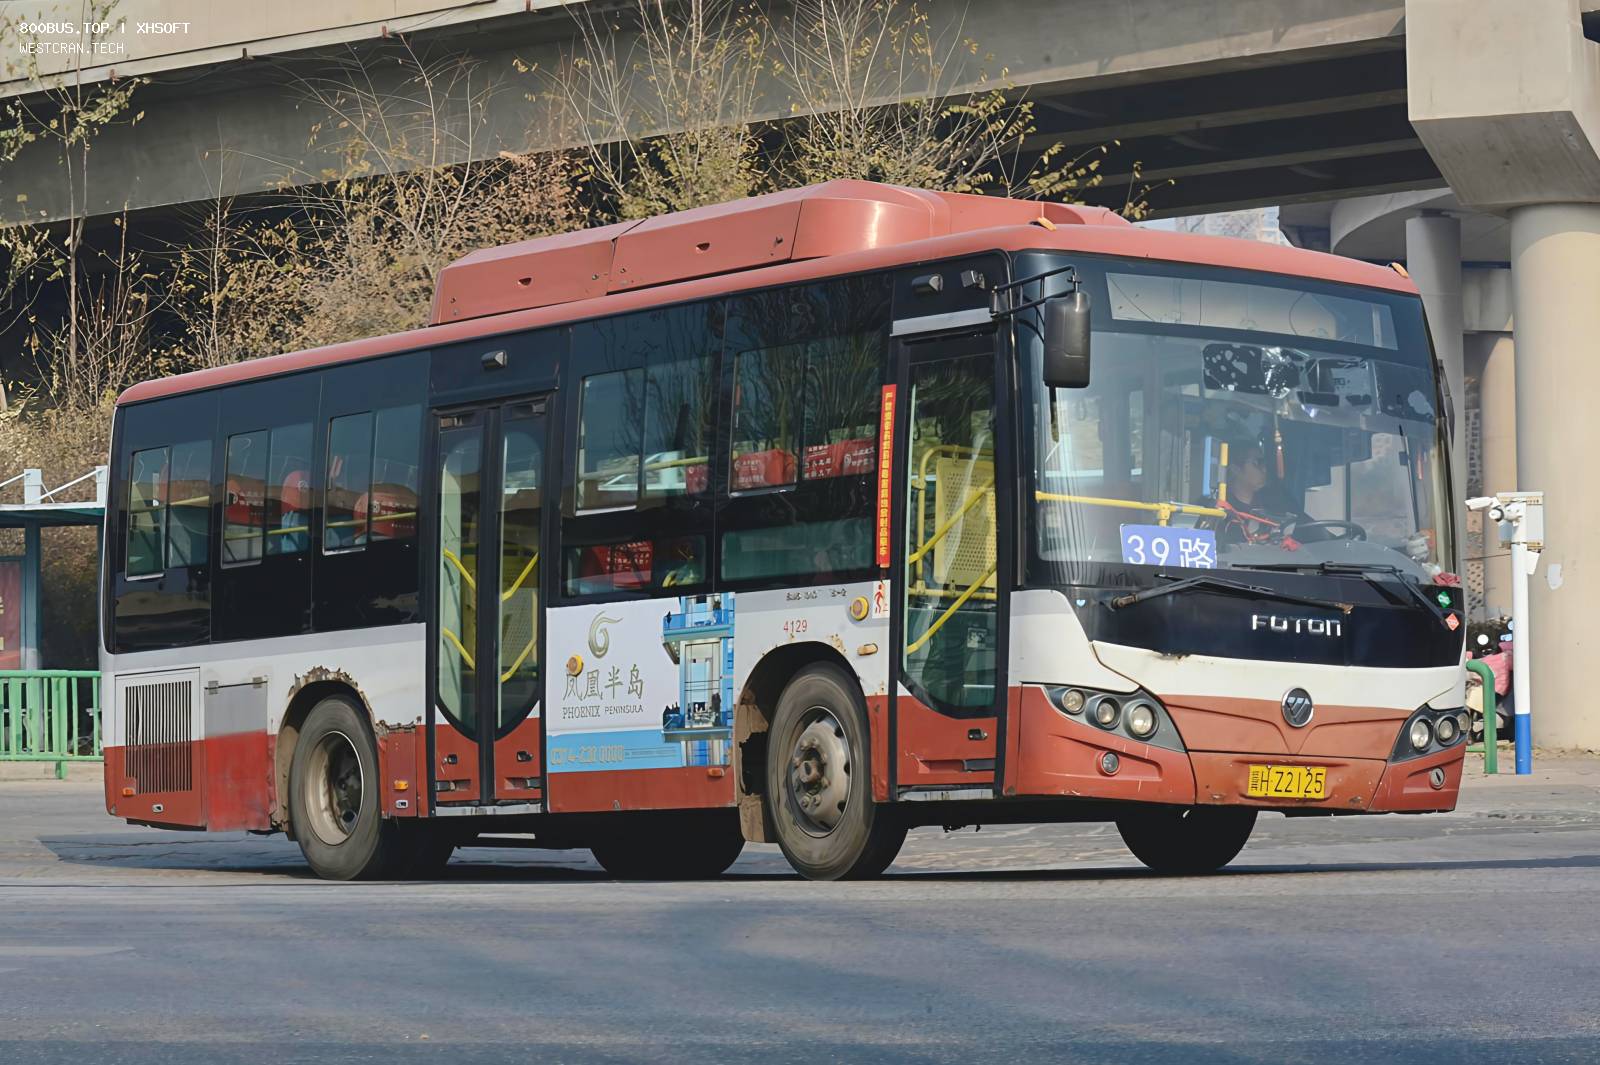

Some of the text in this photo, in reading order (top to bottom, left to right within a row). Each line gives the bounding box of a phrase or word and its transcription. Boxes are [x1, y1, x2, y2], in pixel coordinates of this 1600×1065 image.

[783, 619, 808, 634] 4129
[563, 663, 644, 701] 凤凰半岛
[562, 704, 644, 719] PHOENIX PENINSULA
